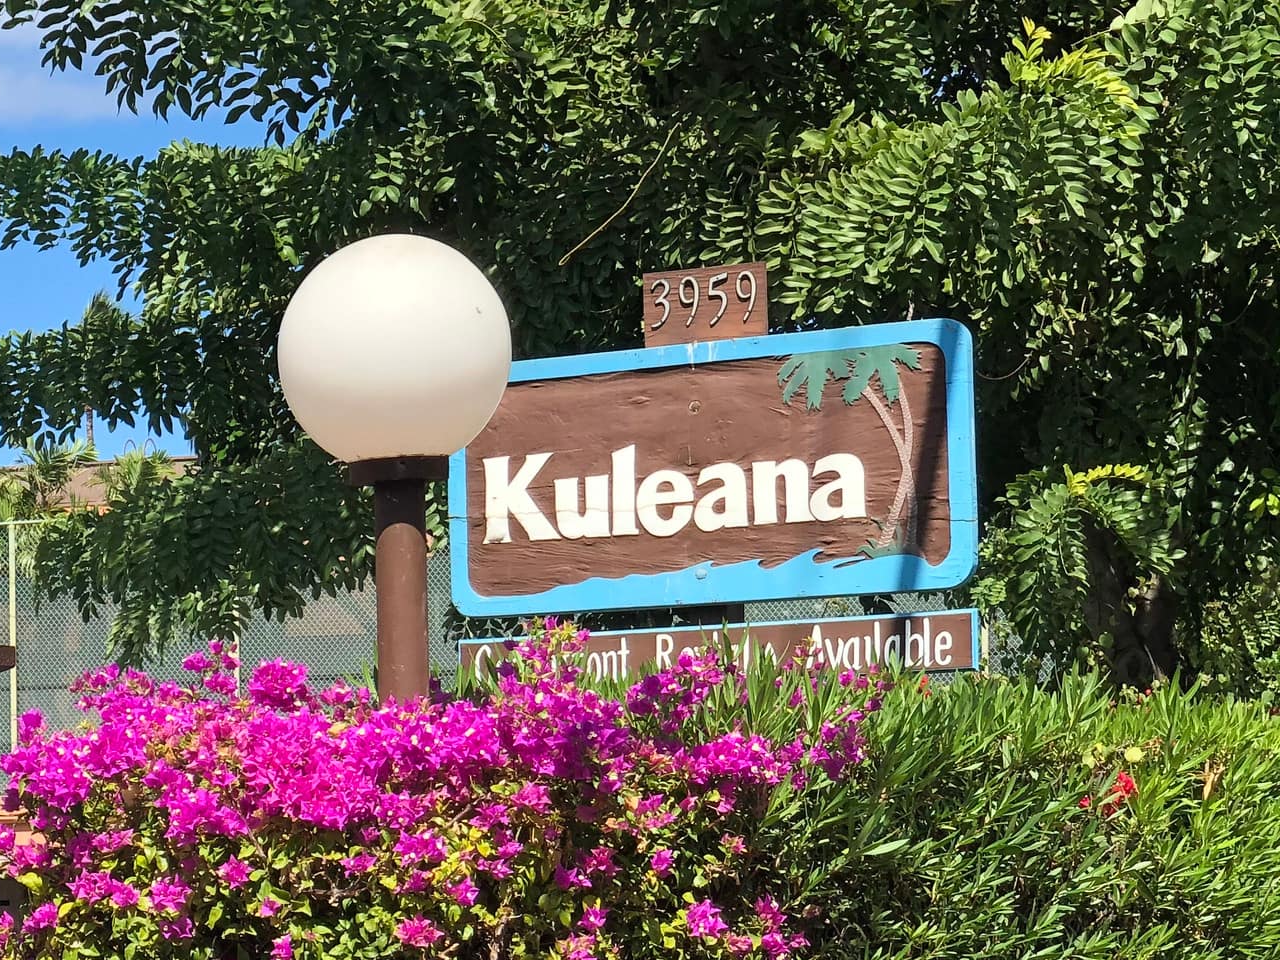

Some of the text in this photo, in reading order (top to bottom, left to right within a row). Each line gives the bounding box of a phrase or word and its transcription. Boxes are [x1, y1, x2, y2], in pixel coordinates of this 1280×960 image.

[650, 270, 757, 329] 3959
[482, 443, 867, 545] Kuleana
[805, 617, 953, 671] Available
